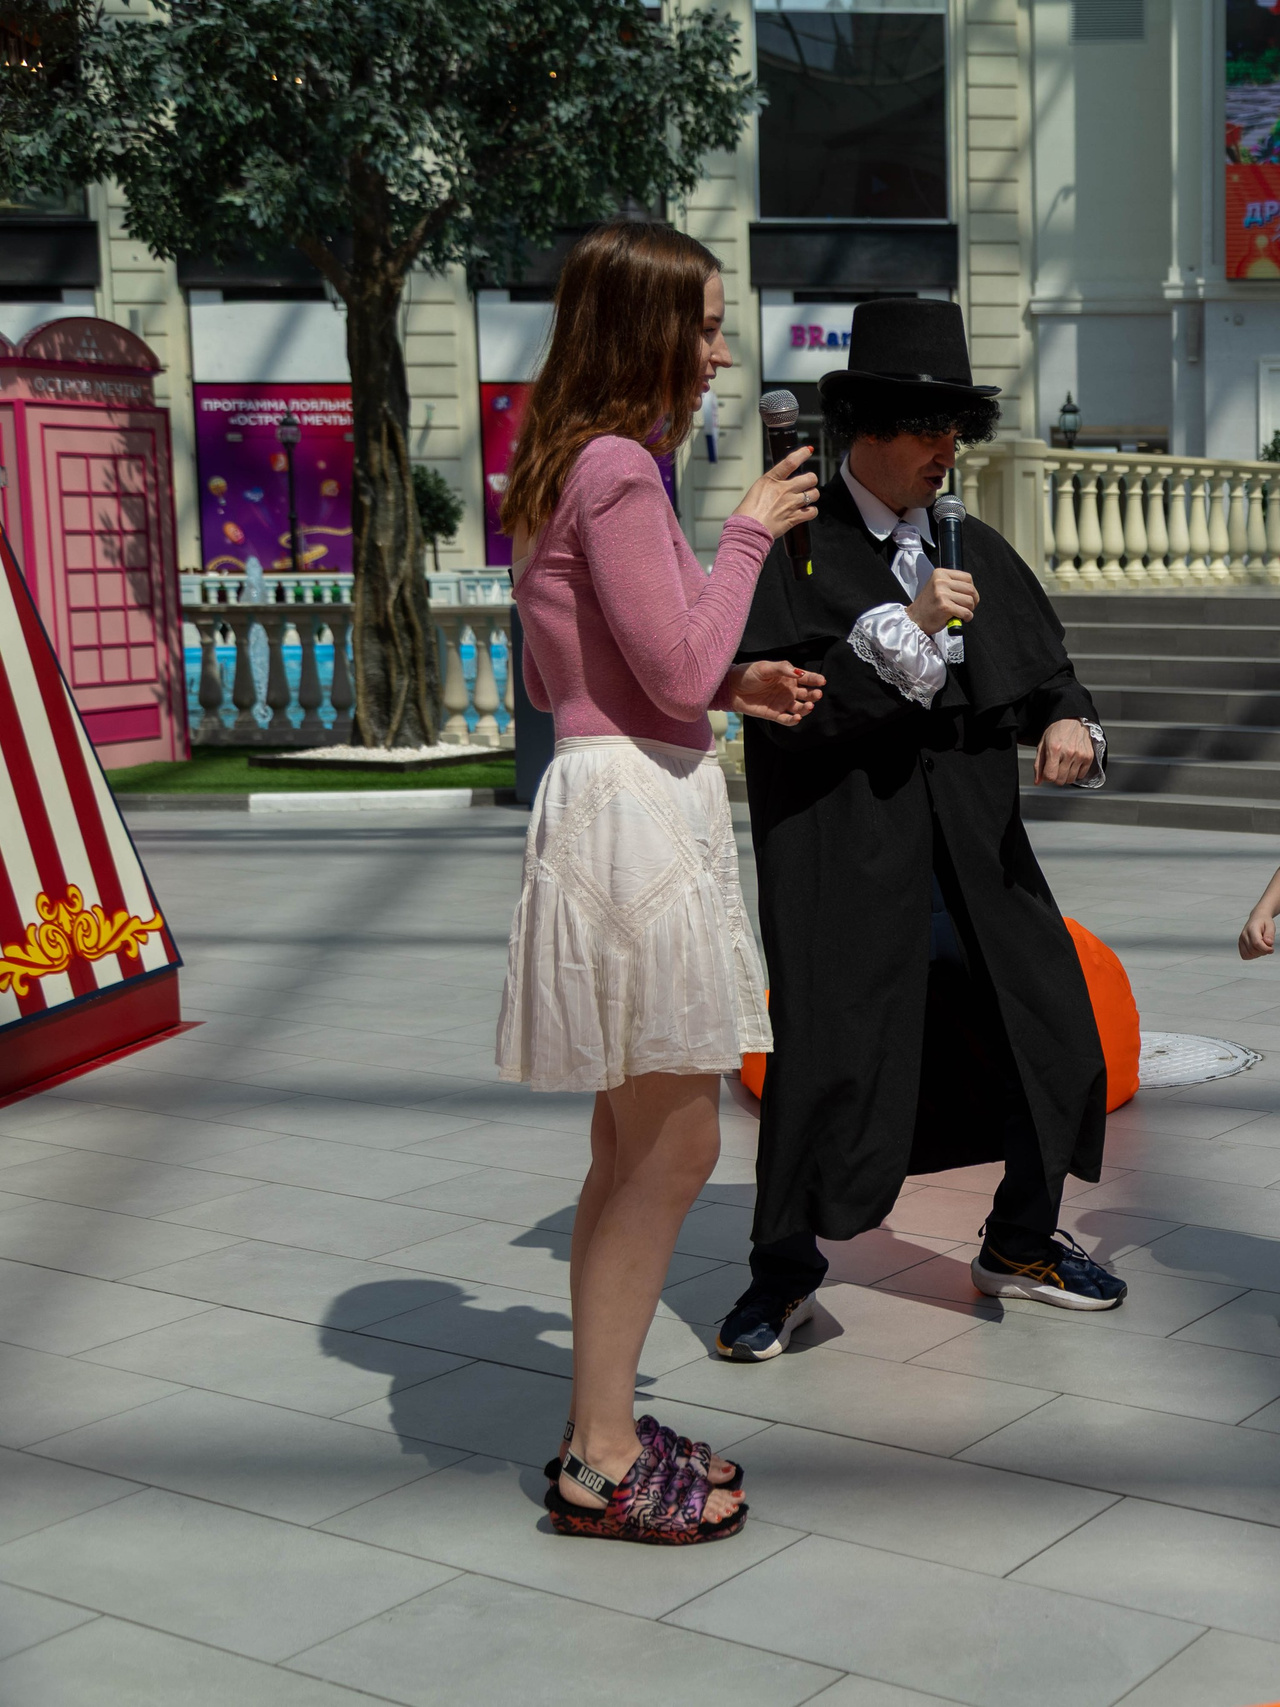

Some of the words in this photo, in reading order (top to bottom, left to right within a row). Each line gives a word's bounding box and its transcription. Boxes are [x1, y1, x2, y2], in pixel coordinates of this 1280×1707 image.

[34, 376, 92, 394] ОСТРОВ
[95, 381, 142, 397] МЕЧТЫ
[202, 399, 288, 411] ПРОГРАММА
[577, 1466, 606, 1492] UGG
